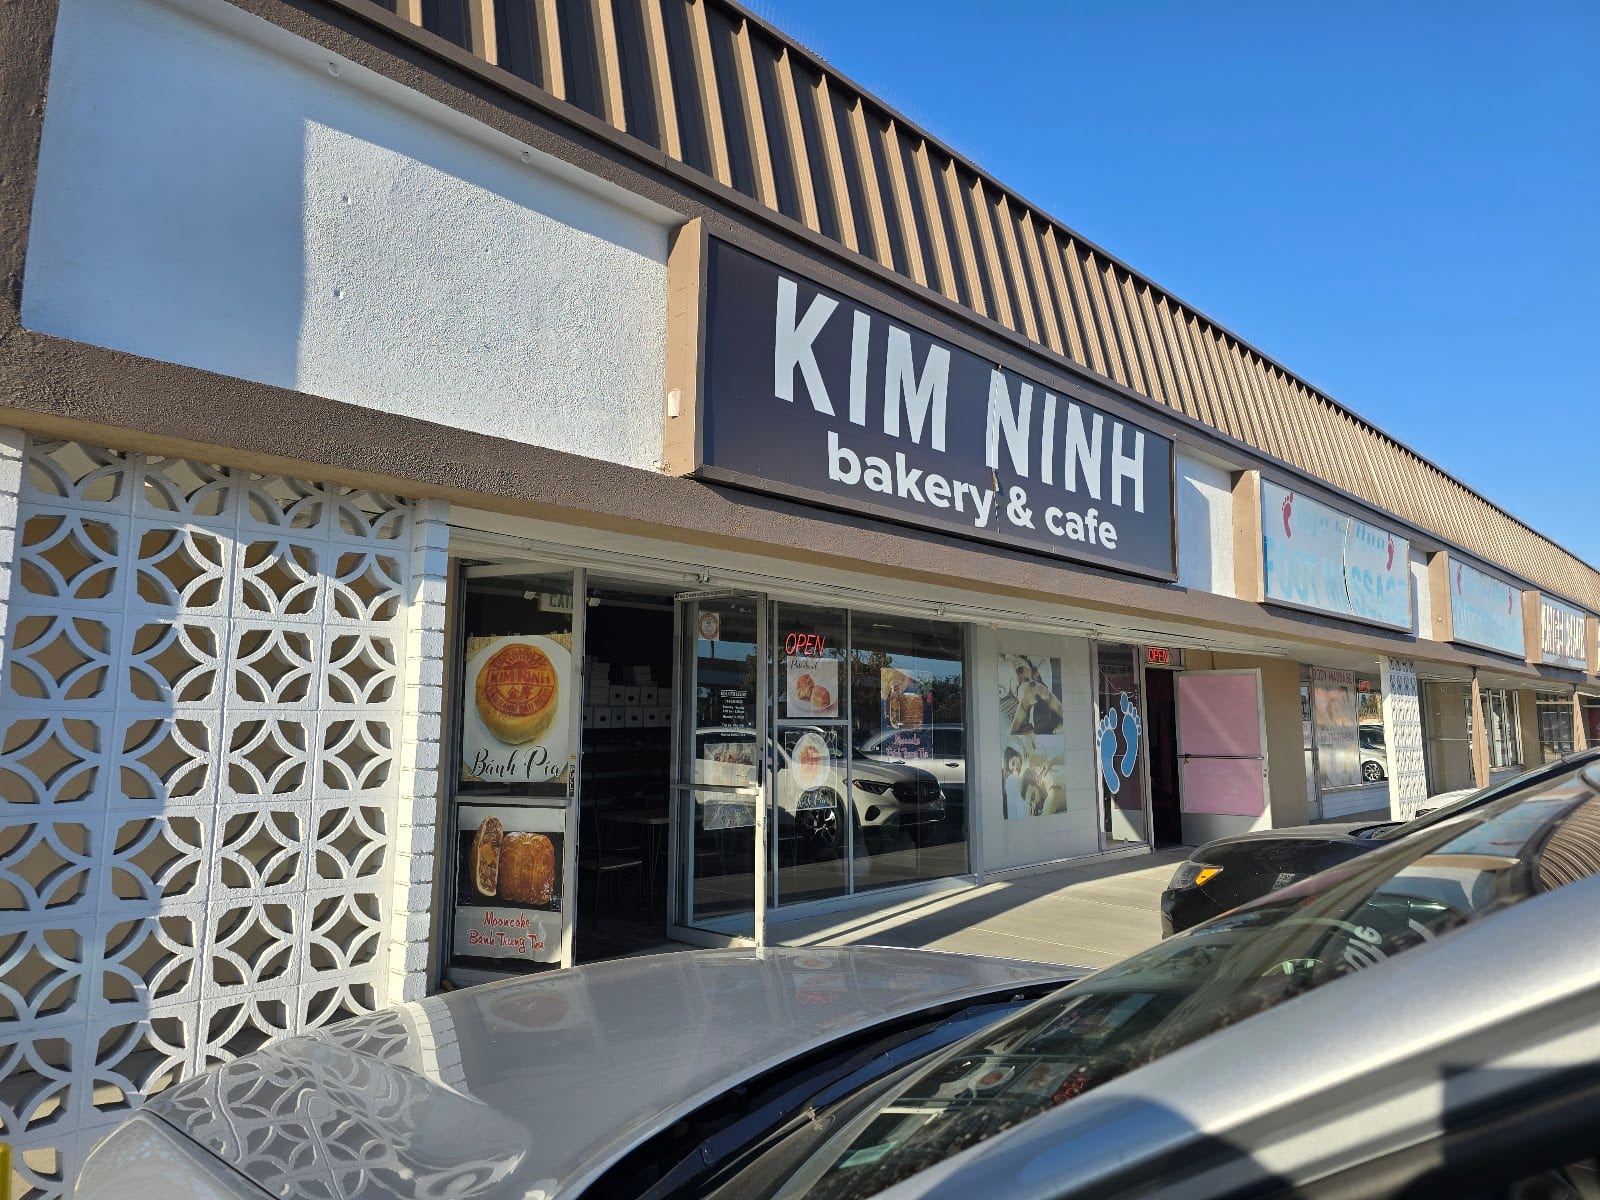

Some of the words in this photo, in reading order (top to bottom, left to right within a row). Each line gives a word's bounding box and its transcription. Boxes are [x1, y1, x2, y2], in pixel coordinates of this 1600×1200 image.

[774, 276, 950, 452] KIM
[985, 368, 1144, 513] NINH
[827, 430, 998, 527] bakery
[1007, 486, 1035, 529] &
[1045, 506, 1117, 549] cafe
[1322, 557, 1409, 627] MSSAGE
[786, 633, 825, 656] OPEN
[1149, 648, 1168, 663] OPEN
[490, 671, 514, 684] KIM
[518, 671, 551, 685] NINH
[469, 747, 519, 778] Bánh
[523, 745, 562, 780] Pía
[483, 910, 531, 928] Mooncake
[467, 929, 495, 945] Bánh
[495, 930, 527, 954] Trung
[526, 933, 545, 950] Thu
